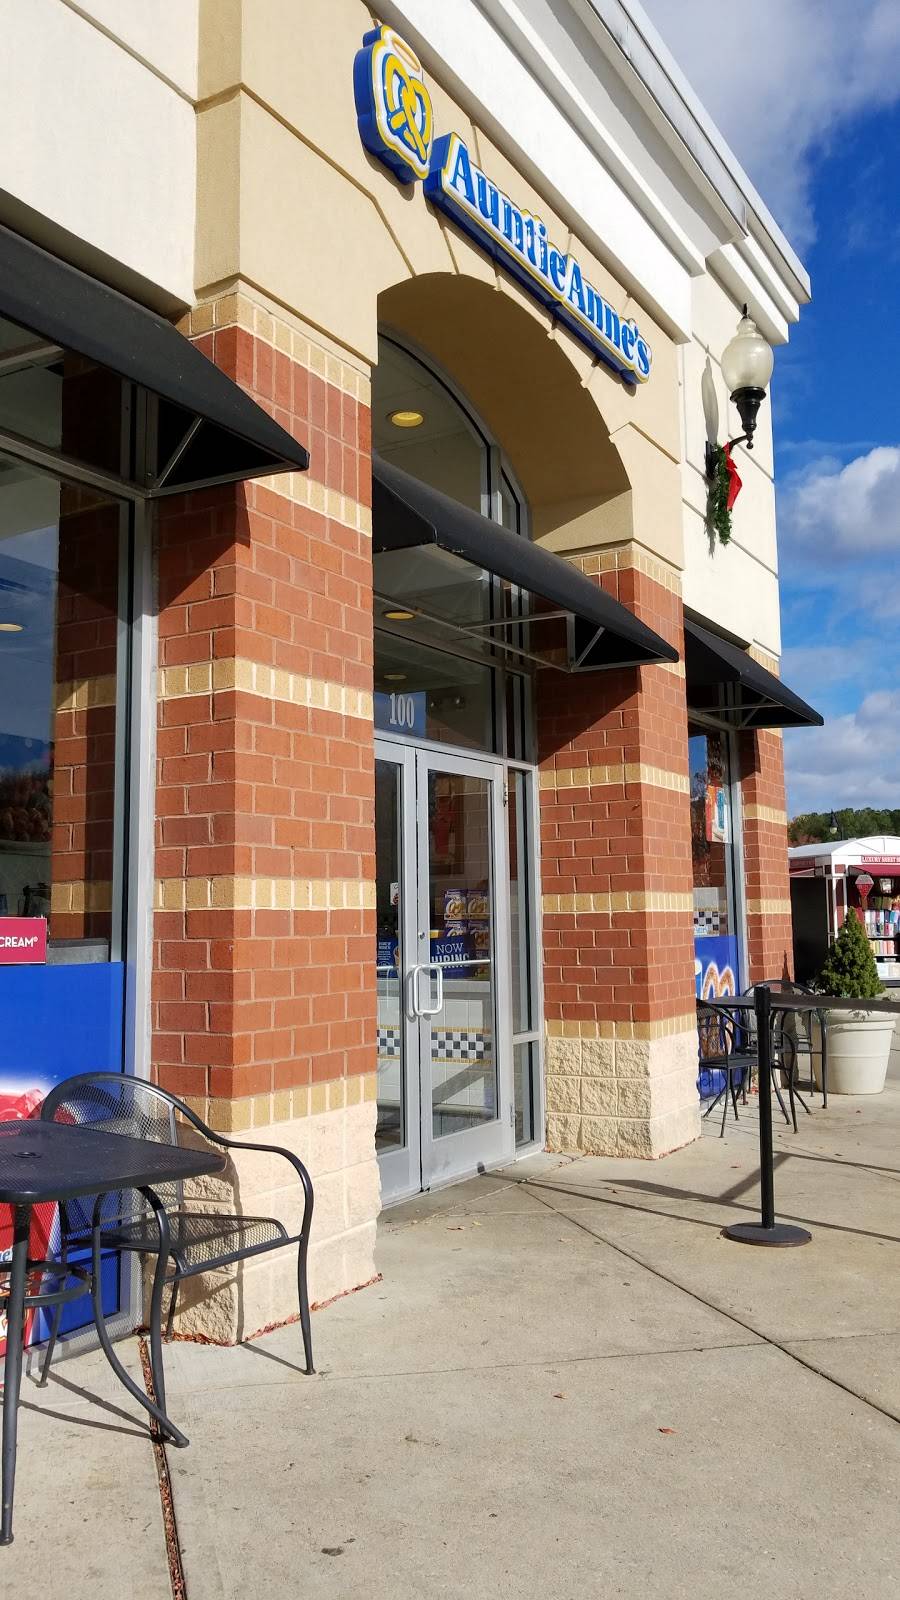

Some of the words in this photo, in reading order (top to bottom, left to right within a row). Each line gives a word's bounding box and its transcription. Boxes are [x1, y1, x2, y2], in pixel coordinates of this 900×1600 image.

[449, 142, 566, 293] Auntie
[567, 259, 651, 376] Anne's
[389, 692, 415, 729] 100
[436, 943, 464, 955] NOW
